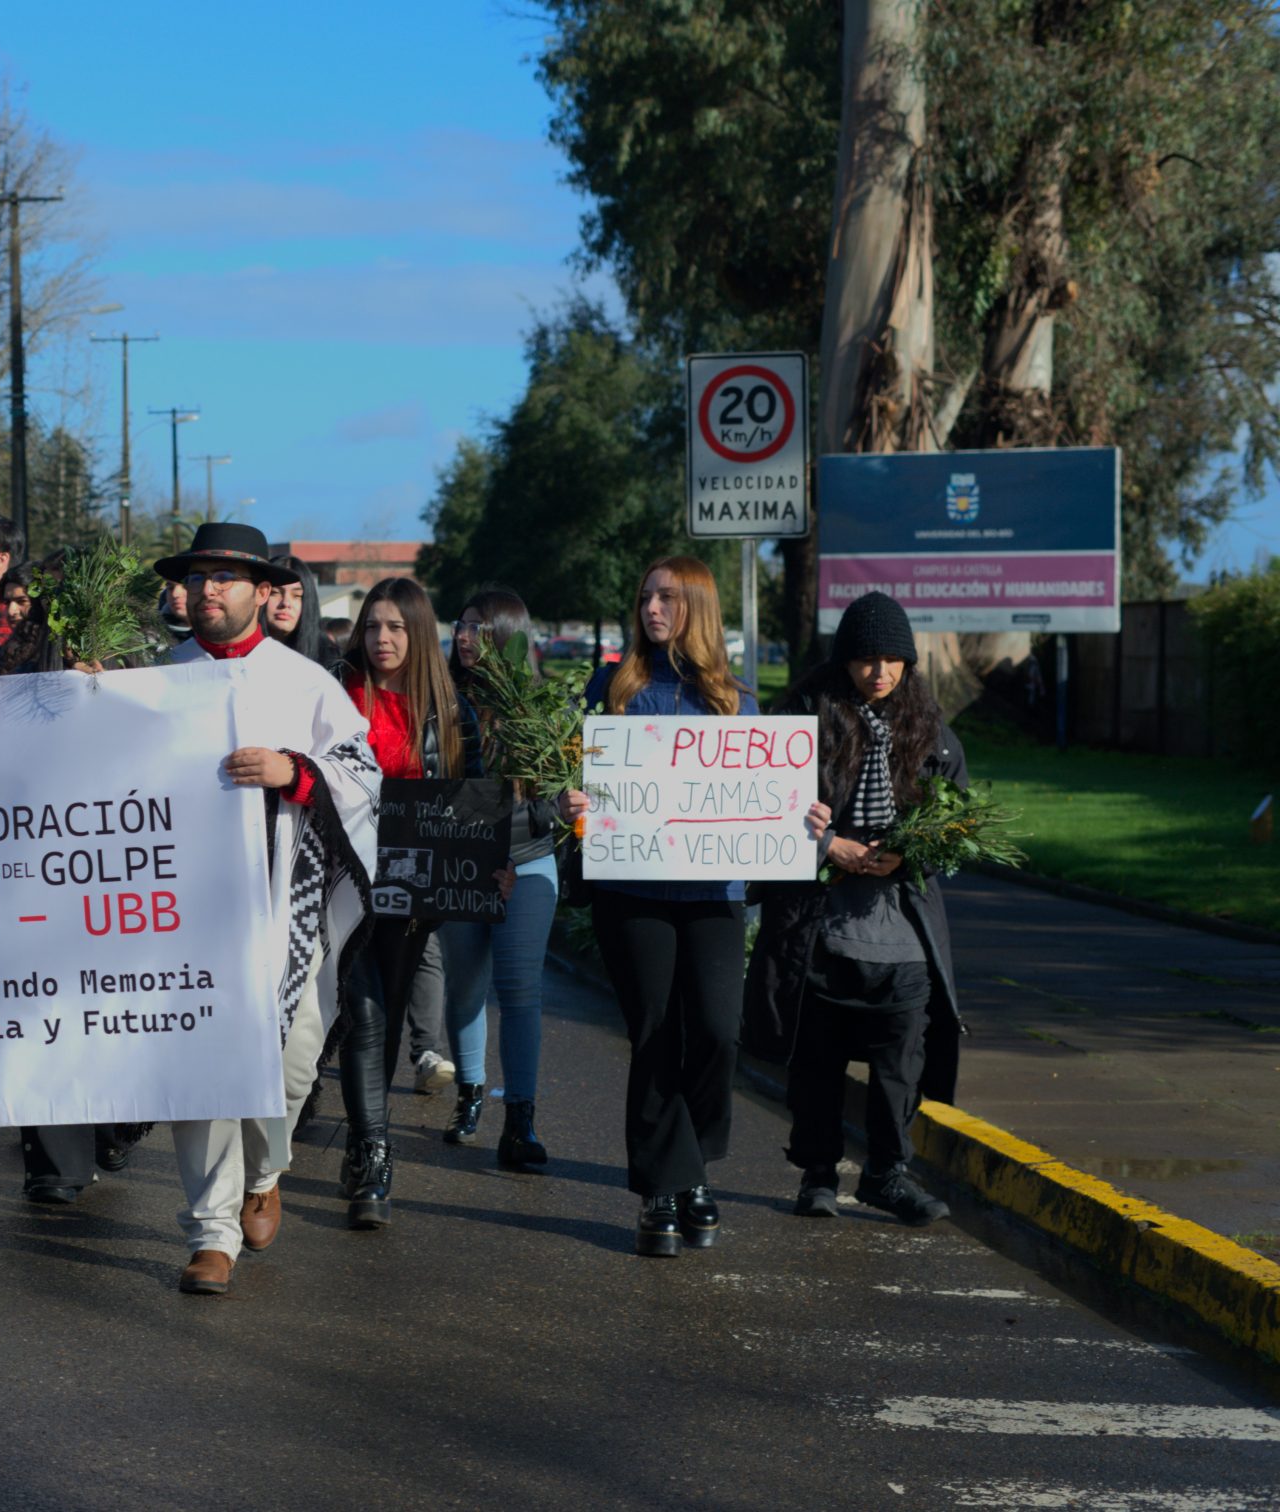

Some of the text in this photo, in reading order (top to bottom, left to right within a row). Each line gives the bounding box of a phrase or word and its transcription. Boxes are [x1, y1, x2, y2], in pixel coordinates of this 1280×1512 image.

[719, 385, 776, 425] 20
[721, 426, 773, 448] Km/h
[698, 475, 799, 491] VELOCIDAD
[698, 500, 797, 521] MAXIMA
[896, 581, 911, 597] DE
[915, 579, 987, 597] EDUCACIÓN
[993, 582, 1002, 597] Y
[1005, 581, 1105, 597] HUMANIDADES
[591, 727, 814, 769] EL PUEBLO
[678, 772, 783, 815] JAMÁS
[588, 827, 797, 865] SERÁ VENCIDO
[2, 862, 35, 879] DEL
[41, 845, 177, 886] GOLPE
[443, 857, 478, 883] NO
[83, 890, 181, 937] UBB
[435, 887, 507, 915] OLVIDAR
[80, 963, 214, 995] Memoria
[43, 1017, 62, 1045] y
